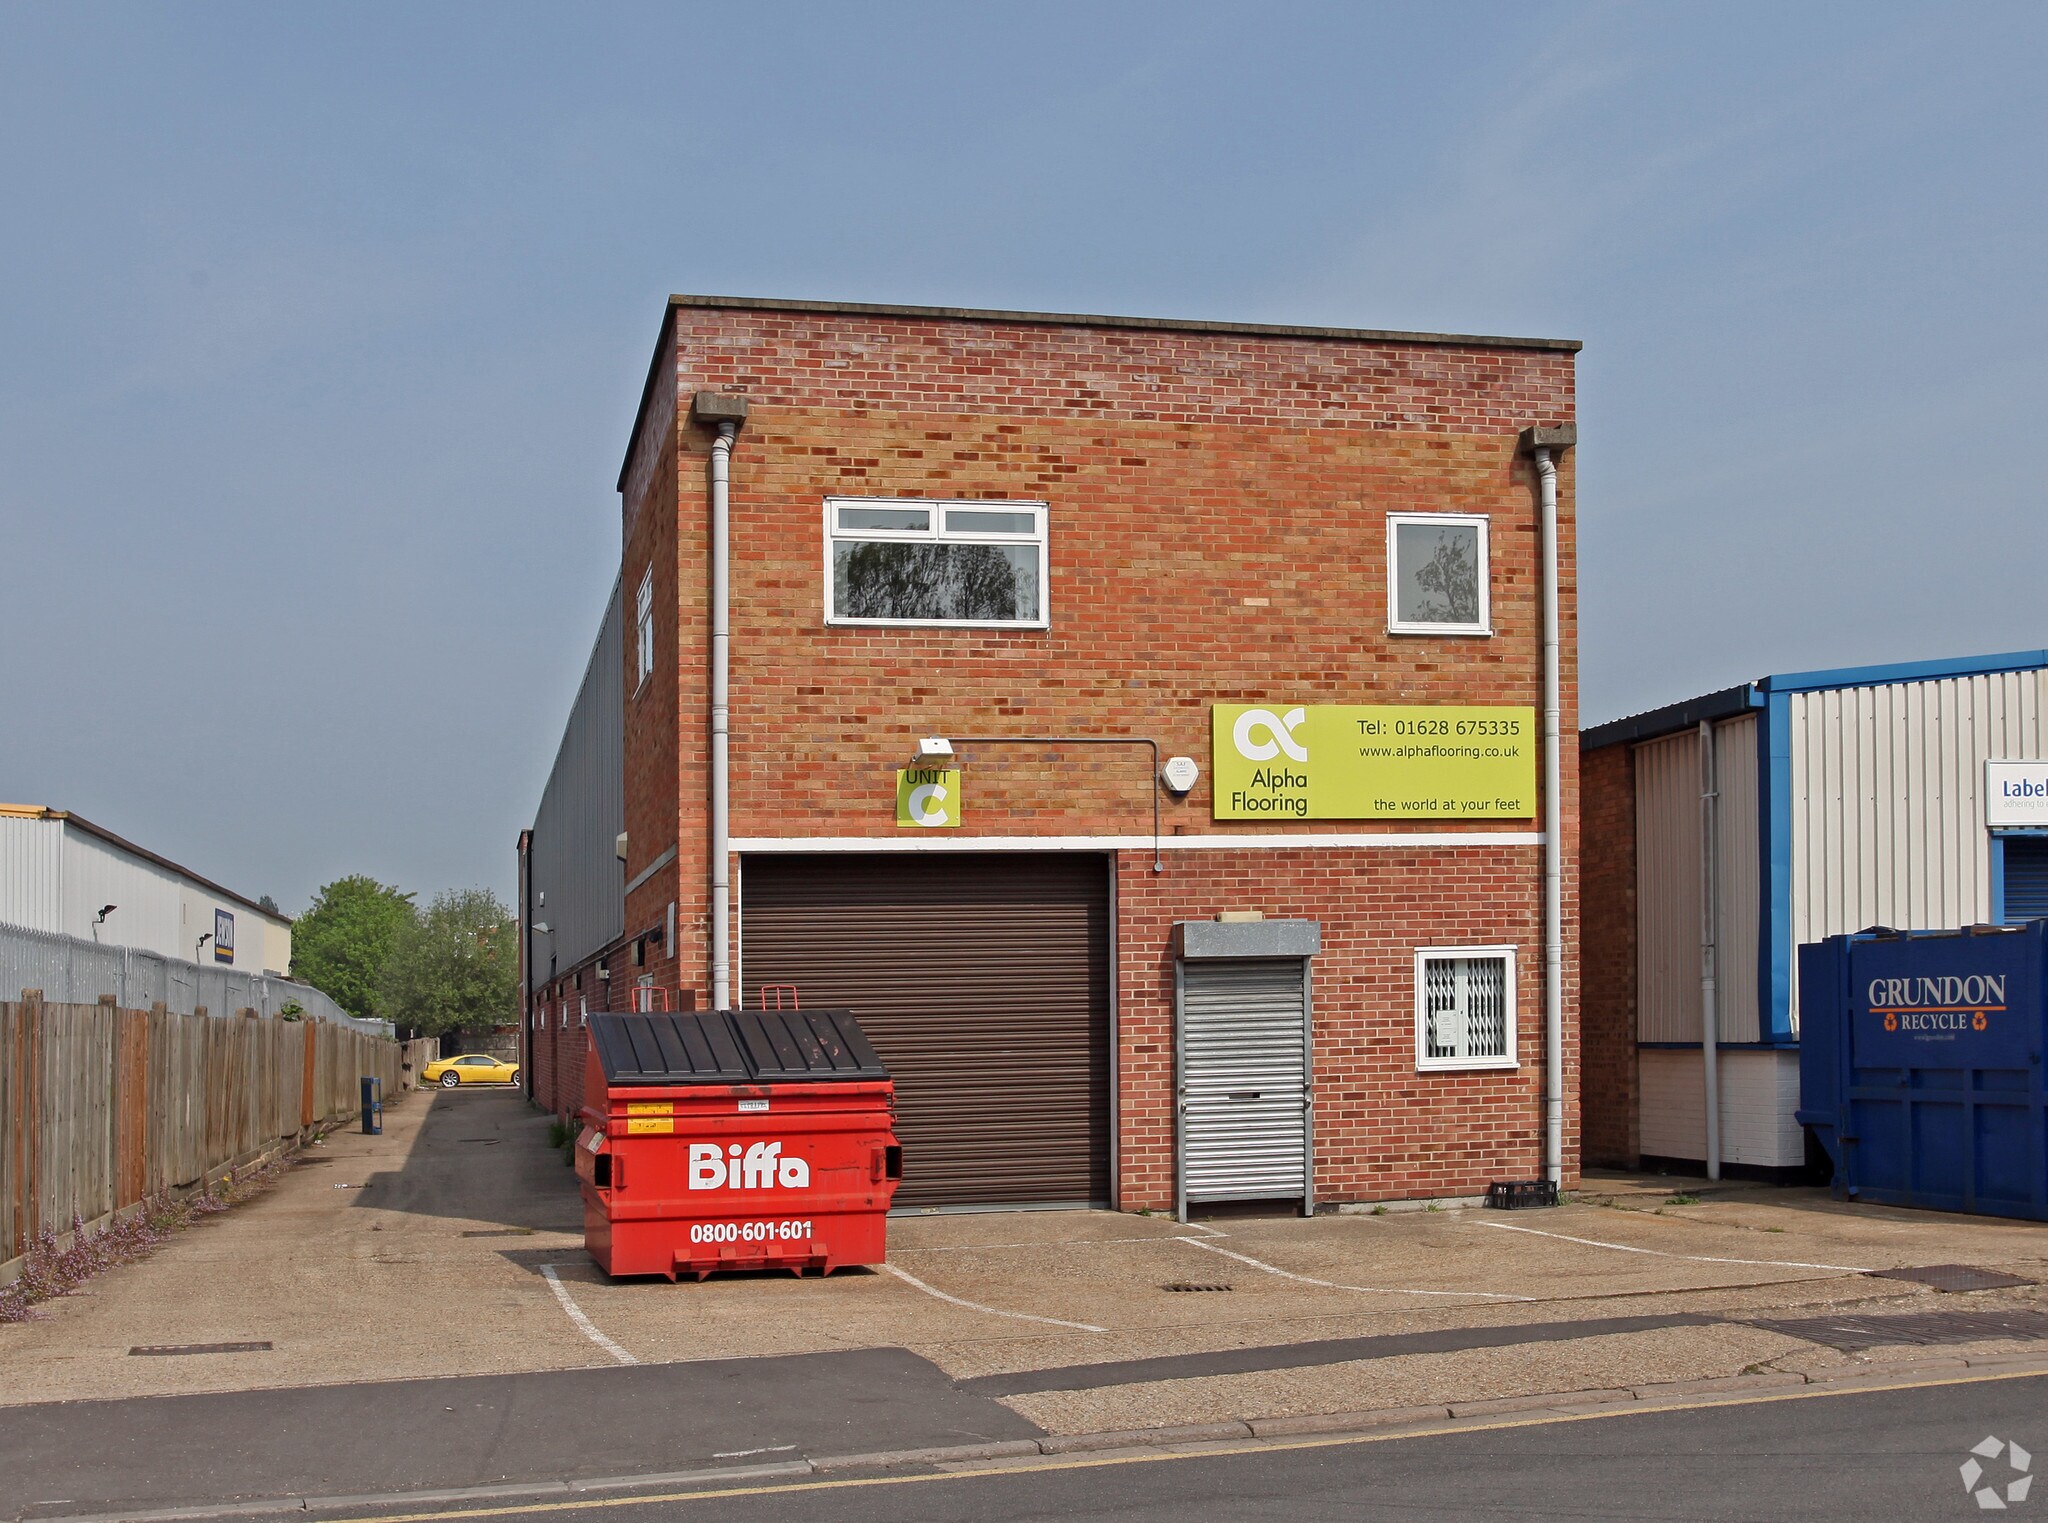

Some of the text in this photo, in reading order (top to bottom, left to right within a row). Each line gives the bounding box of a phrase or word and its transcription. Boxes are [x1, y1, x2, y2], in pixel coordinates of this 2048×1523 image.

[1357, 720, 1520, 736] Tel: 01628 675335
[1359, 745, 1519, 759] www.alphaflooring.co.uk
[906, 770, 951, 784] UNIT
[1250, 768, 1308, 794] Alpha
[909, 783, 949, 827] C
[1232, 791, 1308, 817] Flooring
[1373, 798, 1521, 813] the world at your feet
[1868, 975, 2006, 1007] GRUNDON
[1901, 1013, 1968, 1030] RECYCLE
[688, 1141, 810, 1190] Biffa
